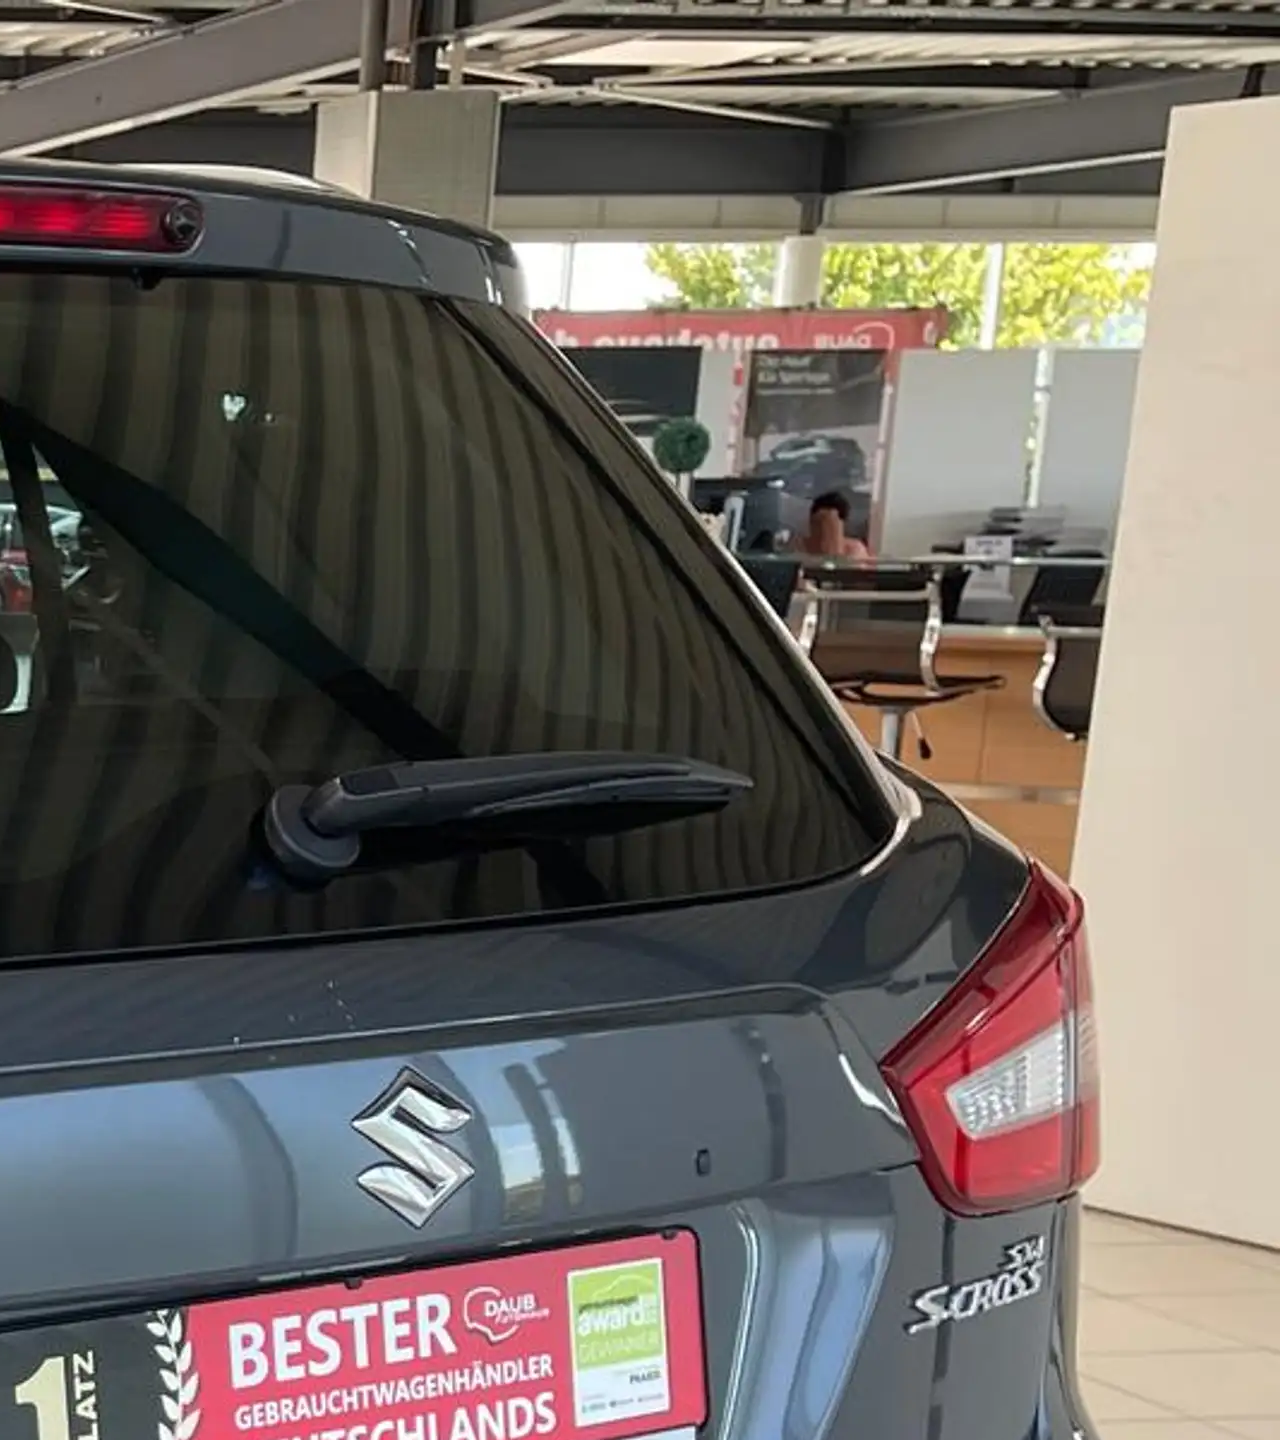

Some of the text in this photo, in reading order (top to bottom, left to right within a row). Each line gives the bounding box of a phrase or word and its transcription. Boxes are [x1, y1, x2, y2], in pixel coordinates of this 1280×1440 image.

[228, 1293, 458, 1390] BESTER
[484, 1294, 536, 1318] DAUB
[234, 1354, 555, 1431] GEBRAUCHTWAGENHÄNDLER
